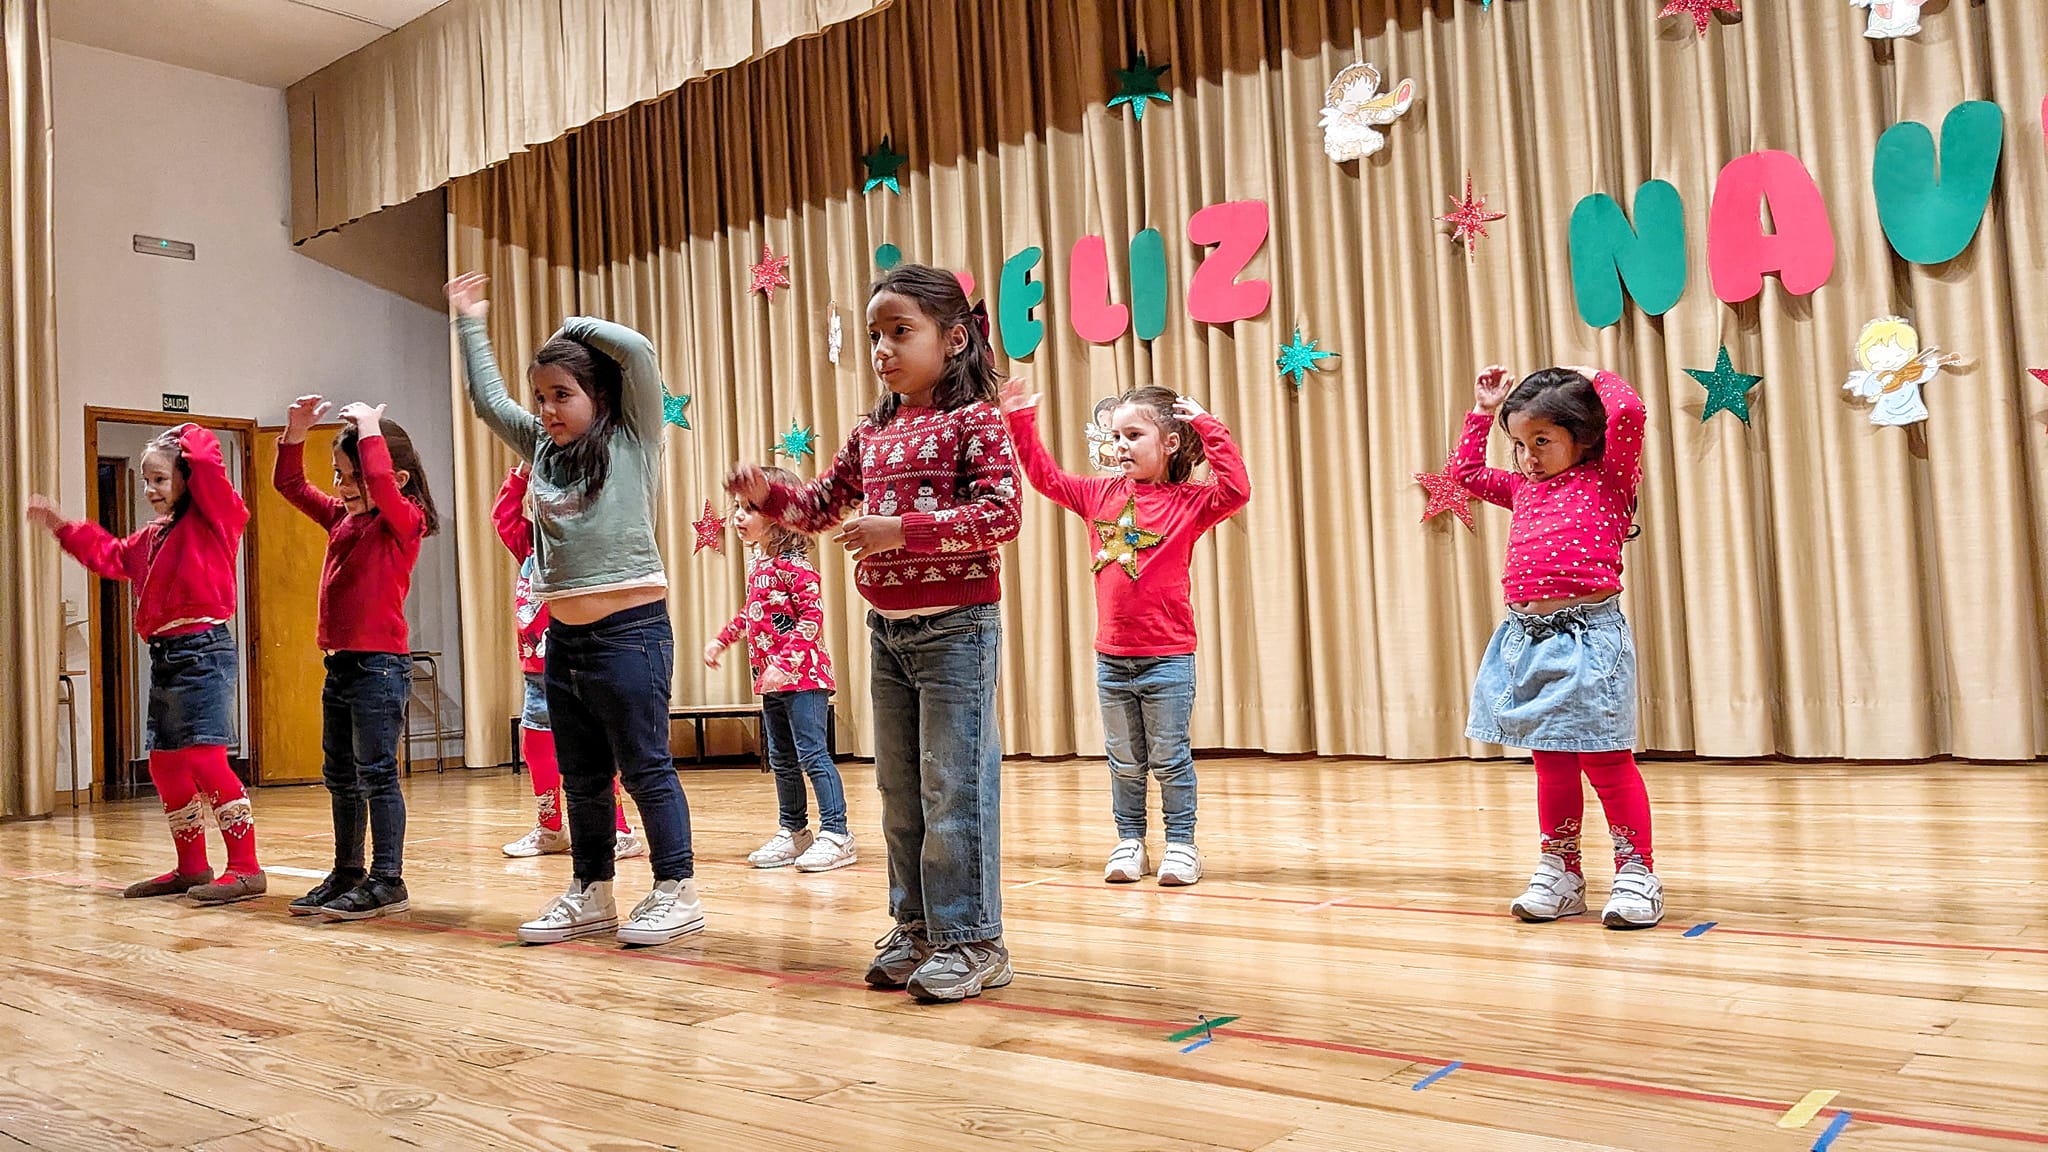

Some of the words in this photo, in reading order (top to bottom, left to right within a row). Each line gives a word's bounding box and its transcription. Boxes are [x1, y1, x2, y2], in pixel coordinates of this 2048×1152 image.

[875, 199, 1272, 359] ELIZ
[1569, 98, 2048, 328] NAV
[163, 397, 188, 409] SALIDA
